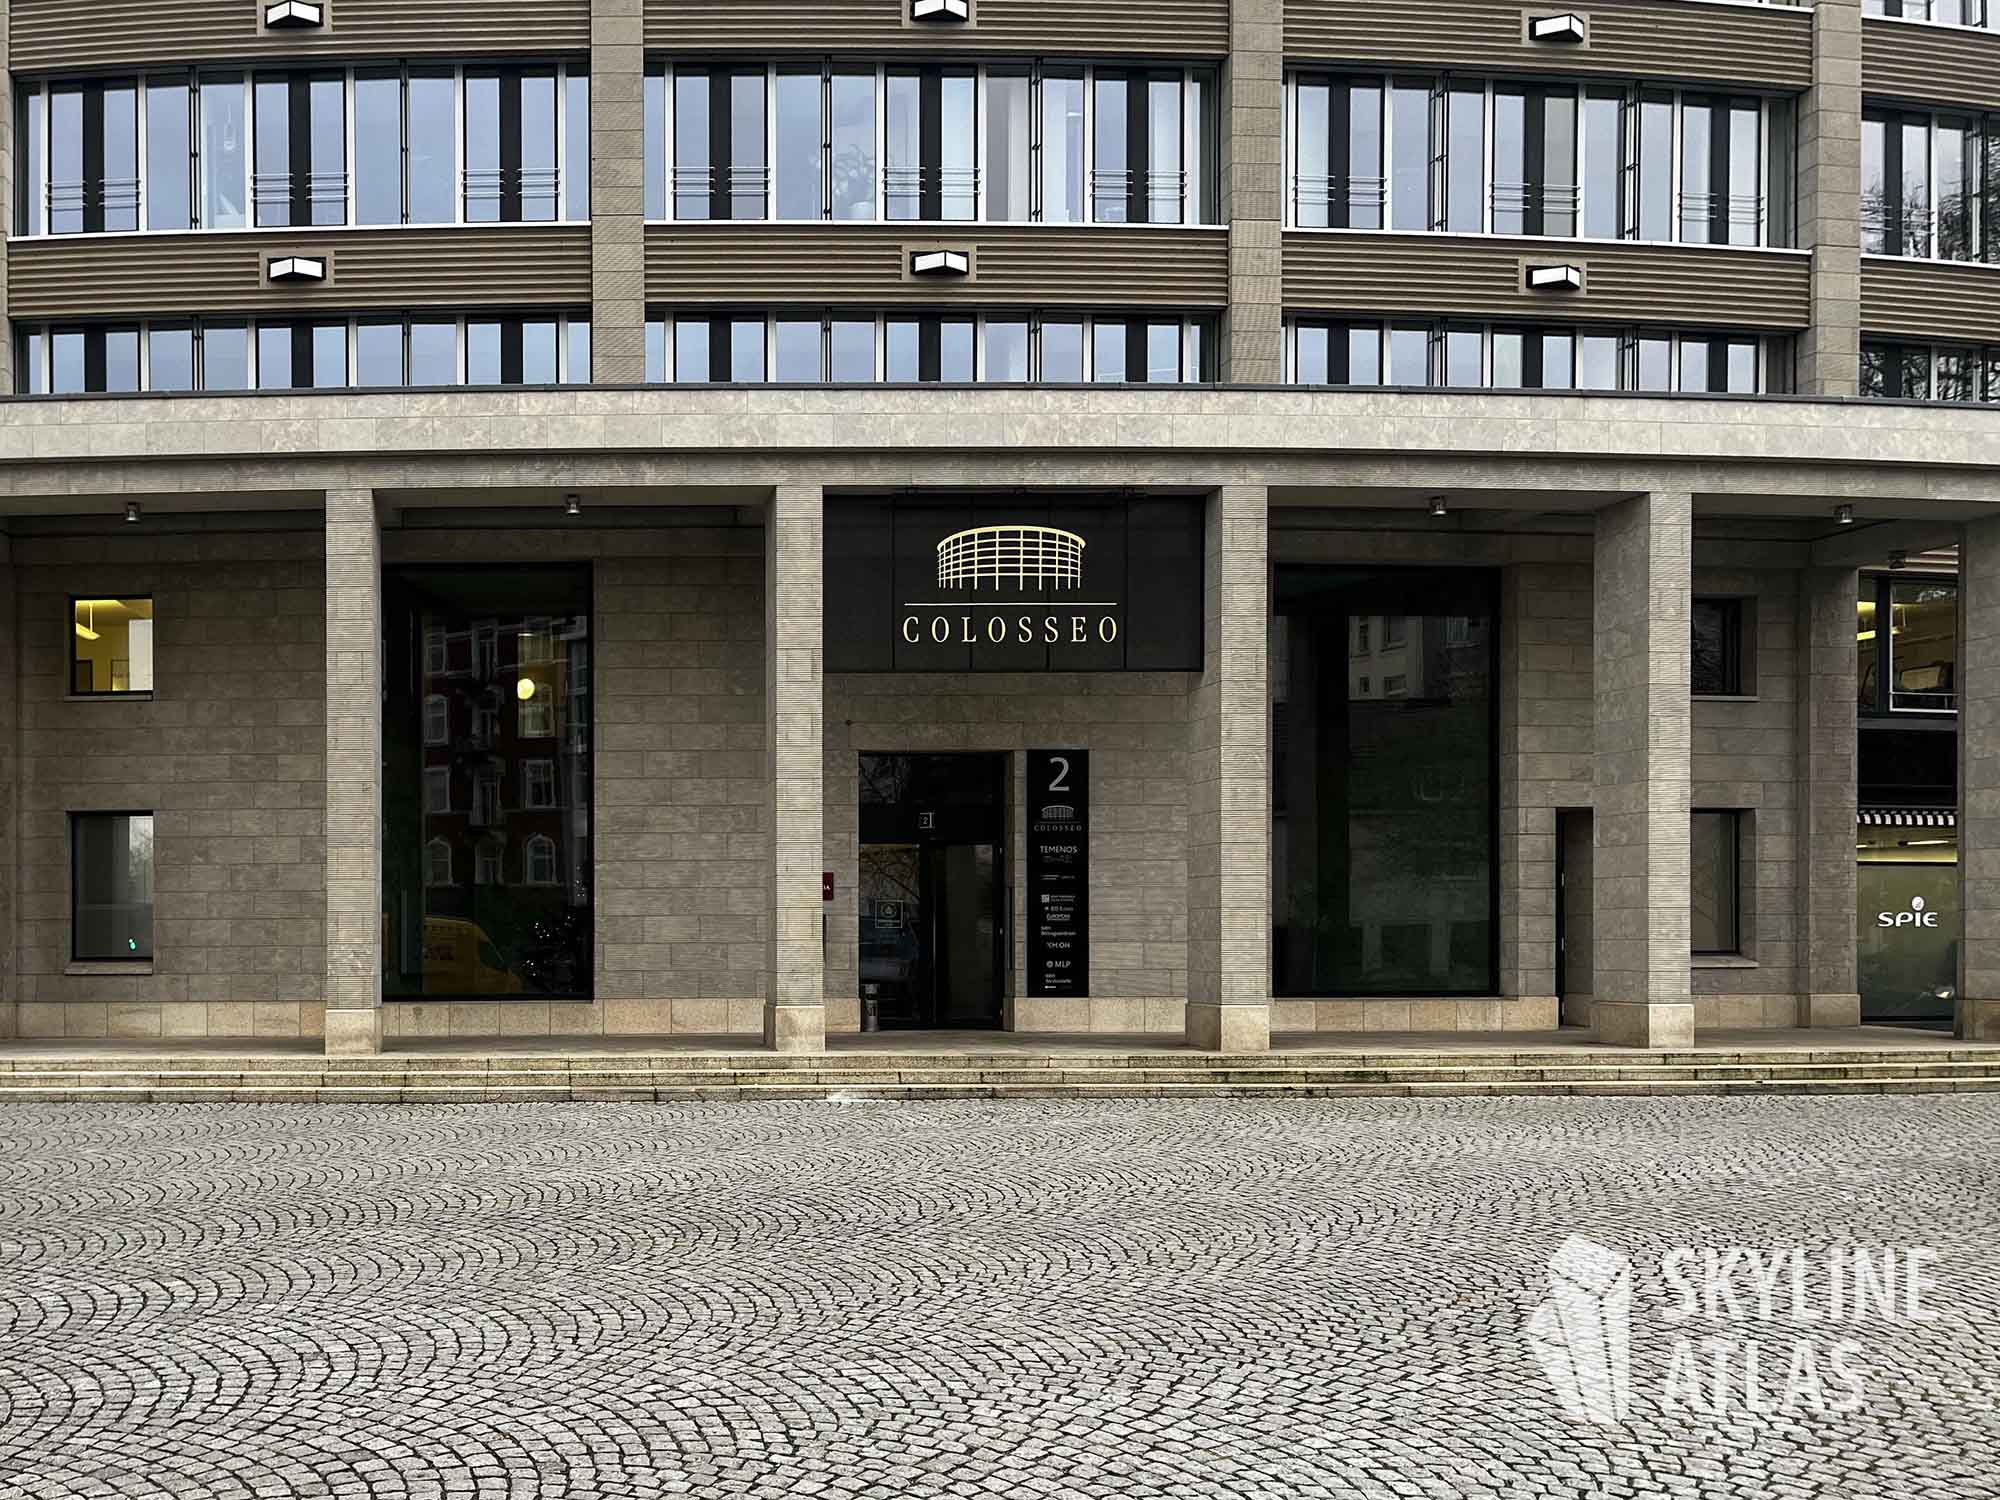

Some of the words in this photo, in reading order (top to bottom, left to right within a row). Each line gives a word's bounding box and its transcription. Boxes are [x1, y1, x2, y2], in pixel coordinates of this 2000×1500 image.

[902, 616, 1118, 643] COLOSSEO
[1048, 756, 1070, 792] 2
[1034, 824, 1082, 832] COLOSSEO
[1039, 845, 1078, 854] TEMENOS
[1877, 897, 1938, 927] SPIE
